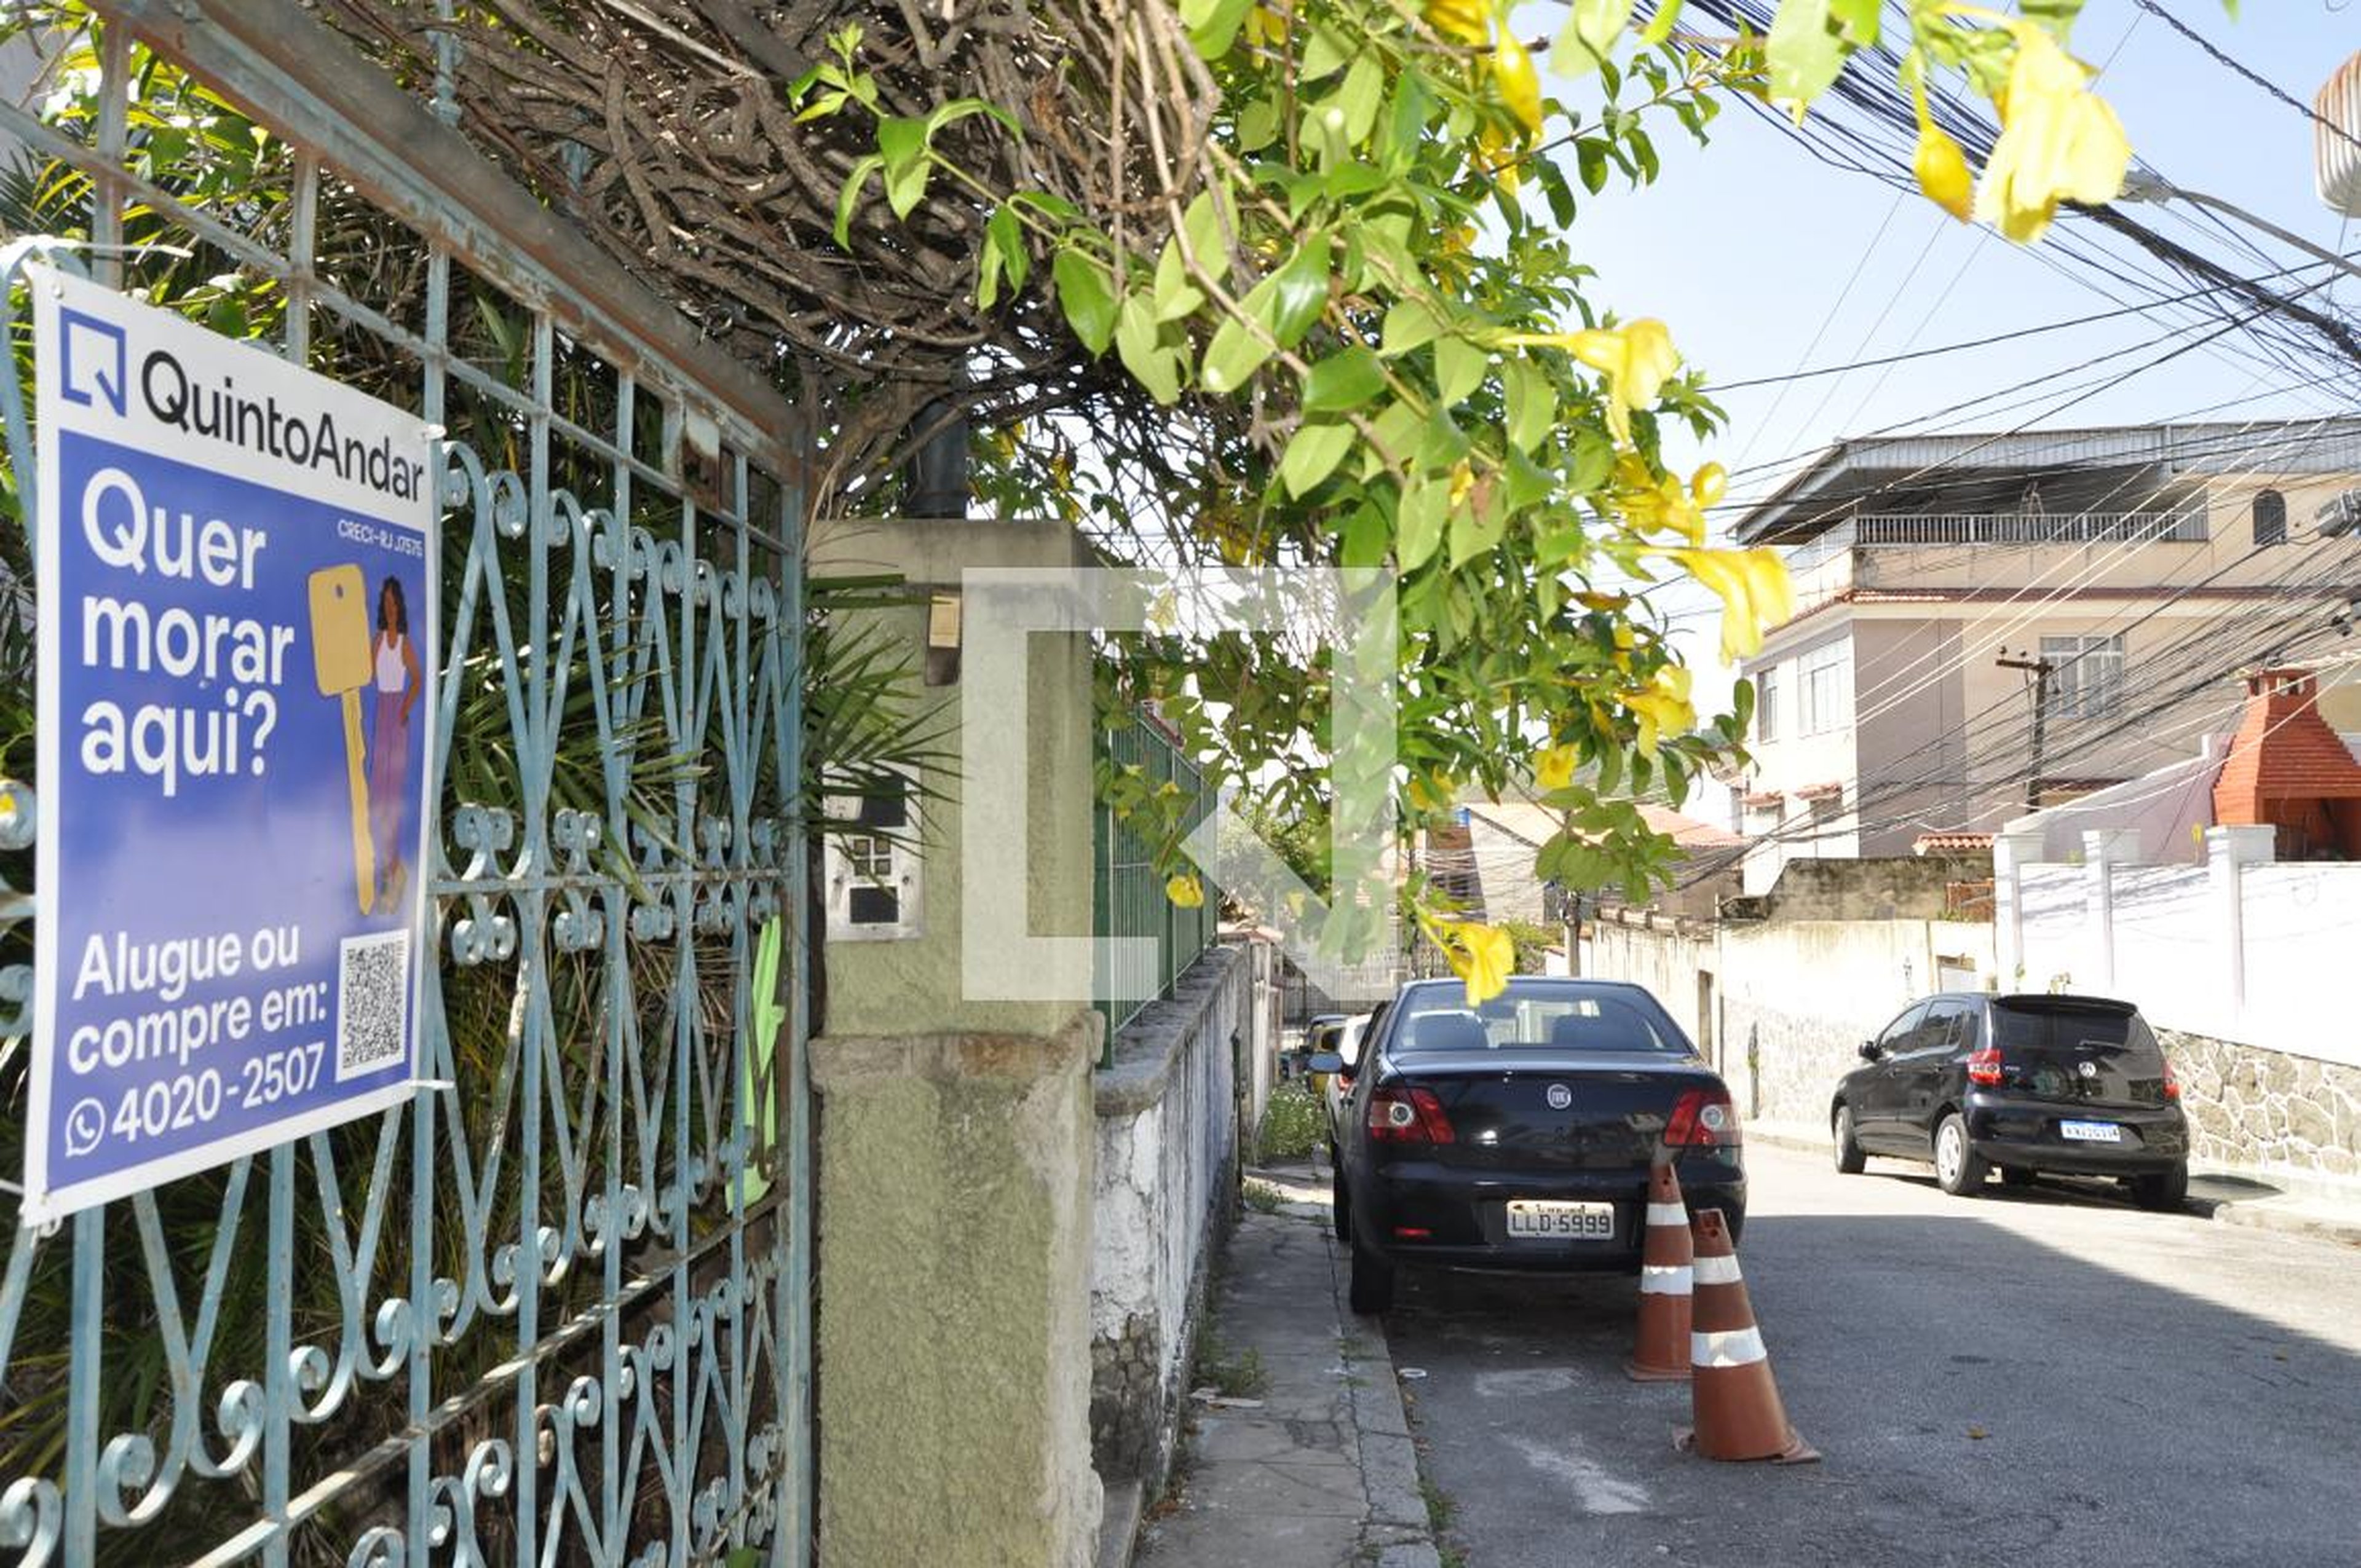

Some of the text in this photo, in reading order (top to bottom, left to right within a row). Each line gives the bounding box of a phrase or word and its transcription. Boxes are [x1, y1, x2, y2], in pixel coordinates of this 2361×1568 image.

[142, 350, 424, 503] QuintoAndar
[82, 468, 266, 589] Quer
[83, 596, 295, 685] morar
[81, 687, 277, 797] aqui?
[73, 926, 299, 1002] Alugue ou
[68, 982, 328, 1074] compre em:
[111, 1042, 325, 1142] 4020-2507
